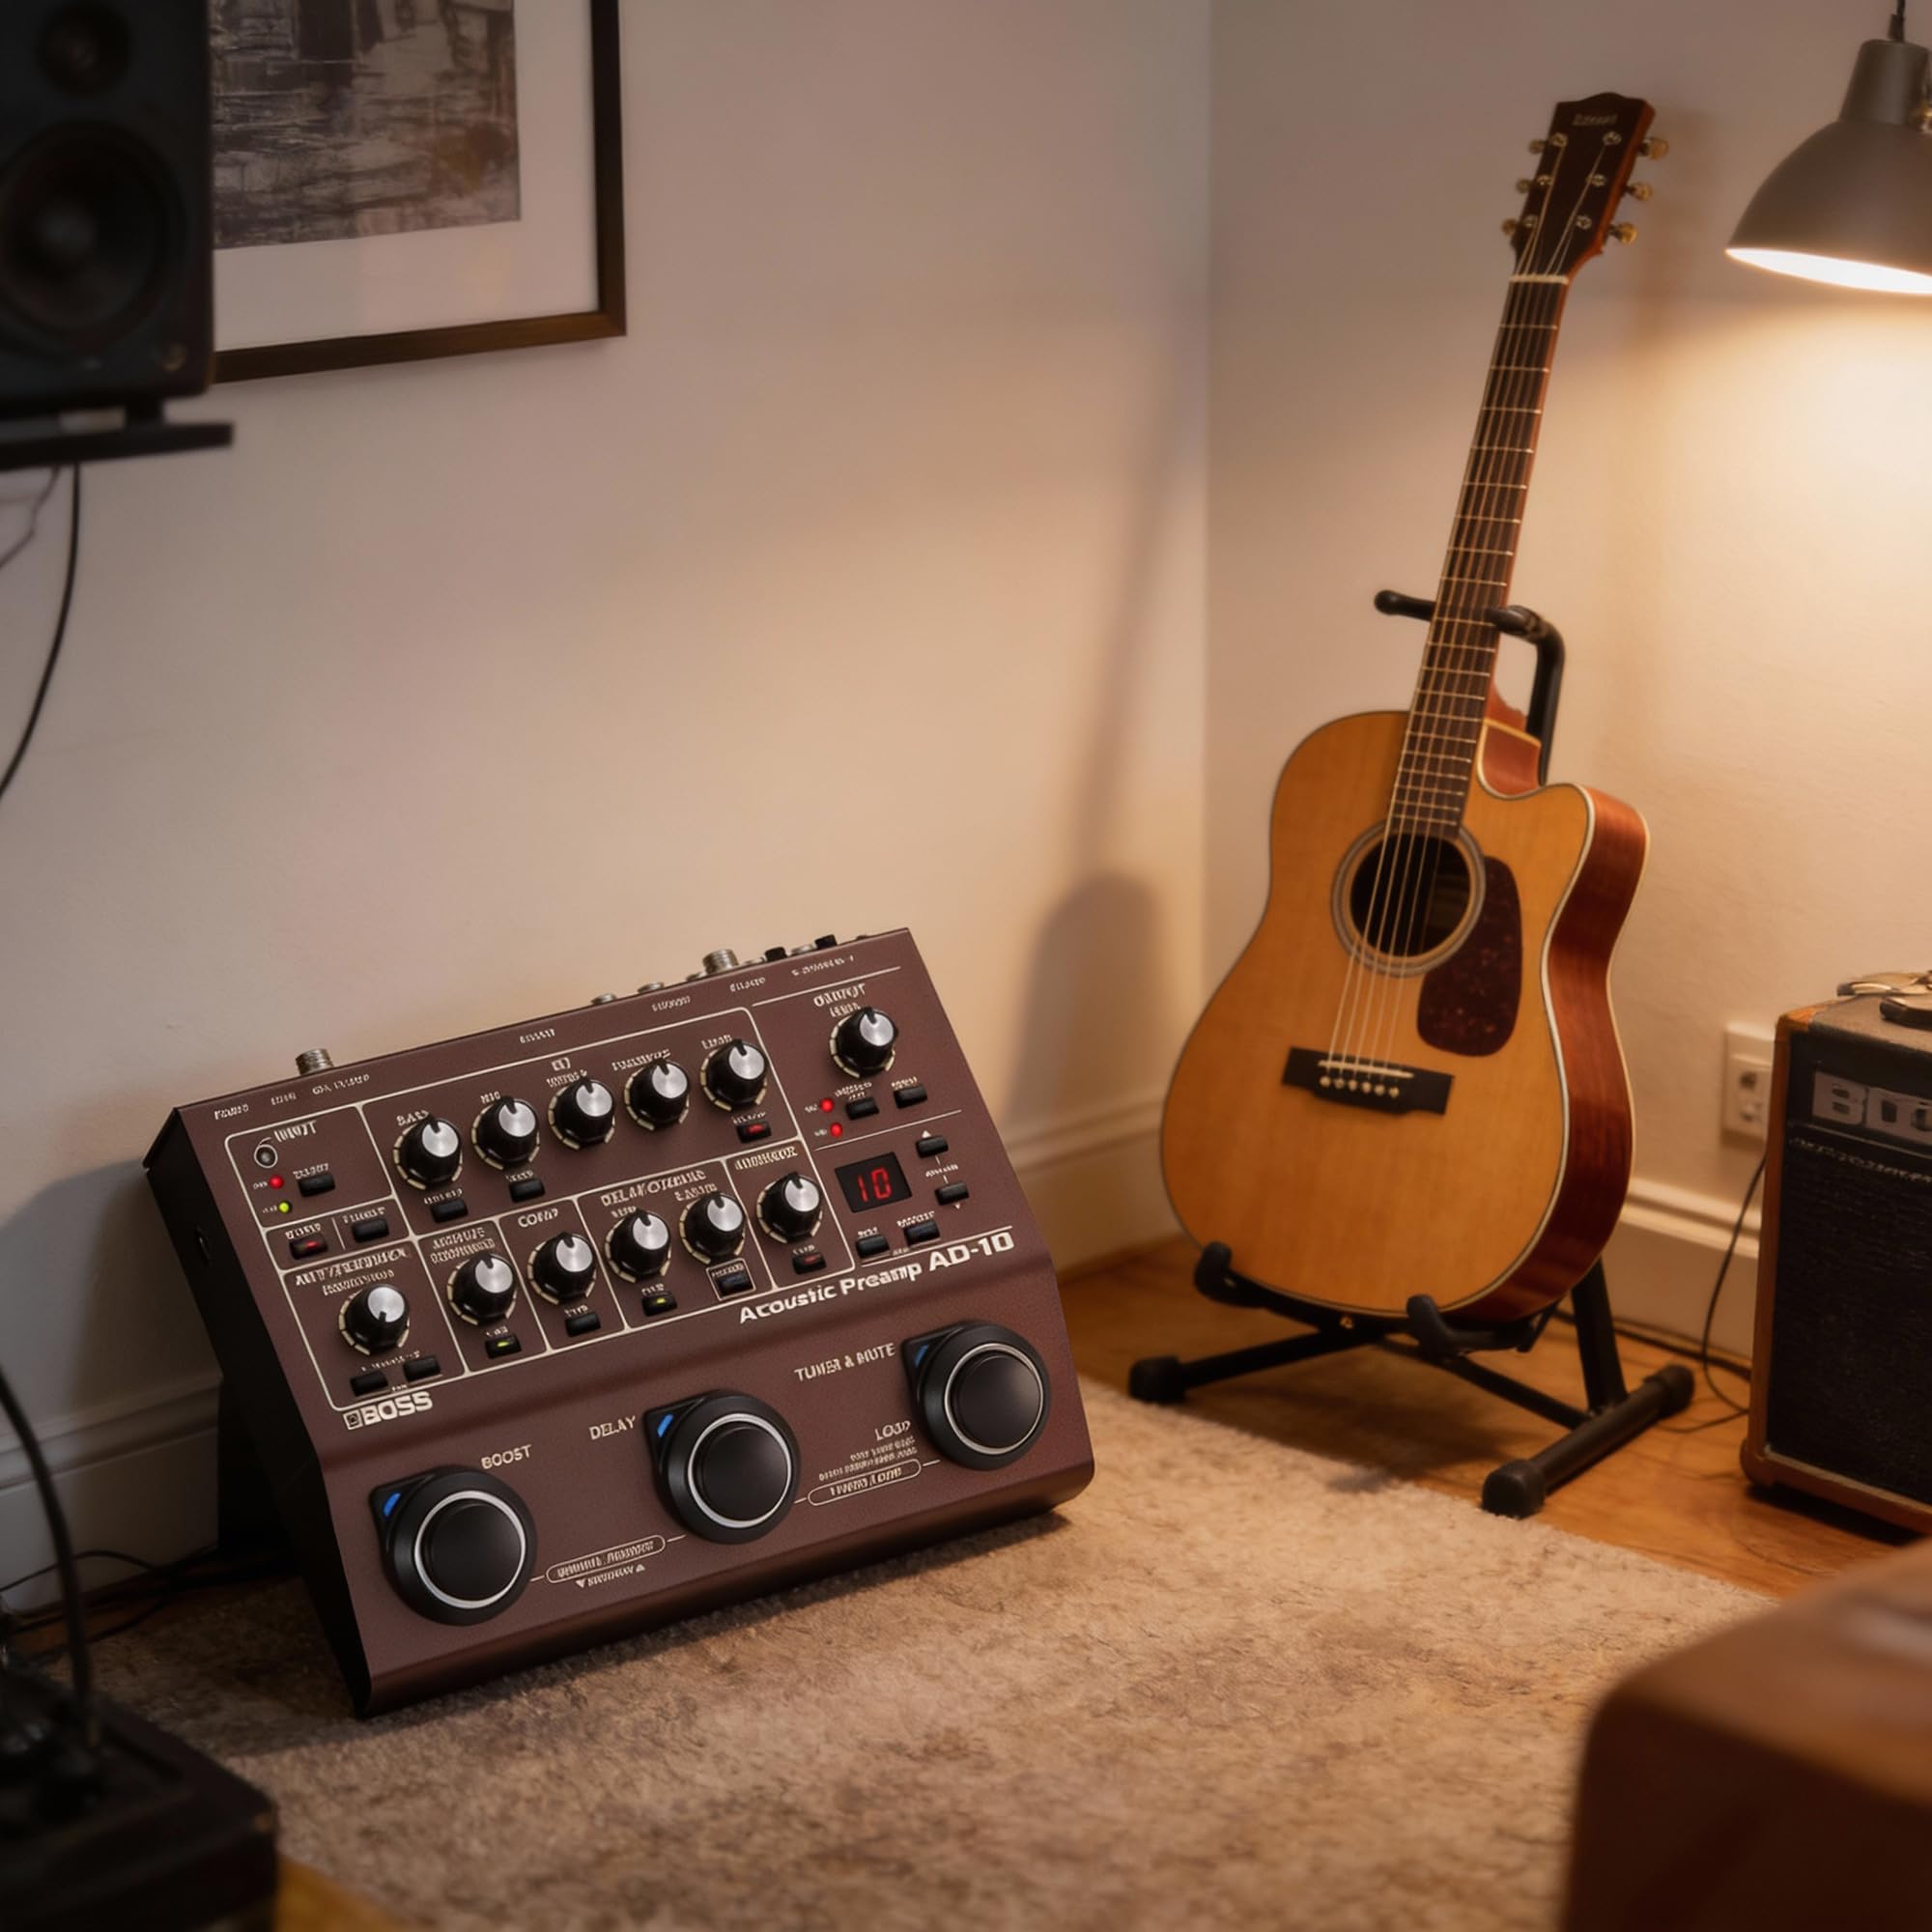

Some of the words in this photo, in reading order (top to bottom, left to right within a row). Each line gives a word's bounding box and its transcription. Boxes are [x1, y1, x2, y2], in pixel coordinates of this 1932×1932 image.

[856, 1166, 893, 1203] 10
[739, 1283, 838, 1323] Acoustic
[839, 1261, 923, 1295] Preamp
[928, 1231, 1015, 1272] AD-10
[363, 1391, 434, 1425] BOSS
[588, 1415, 636, 1439] DELAY
[480, 1444, 531, 1469] BOOST
